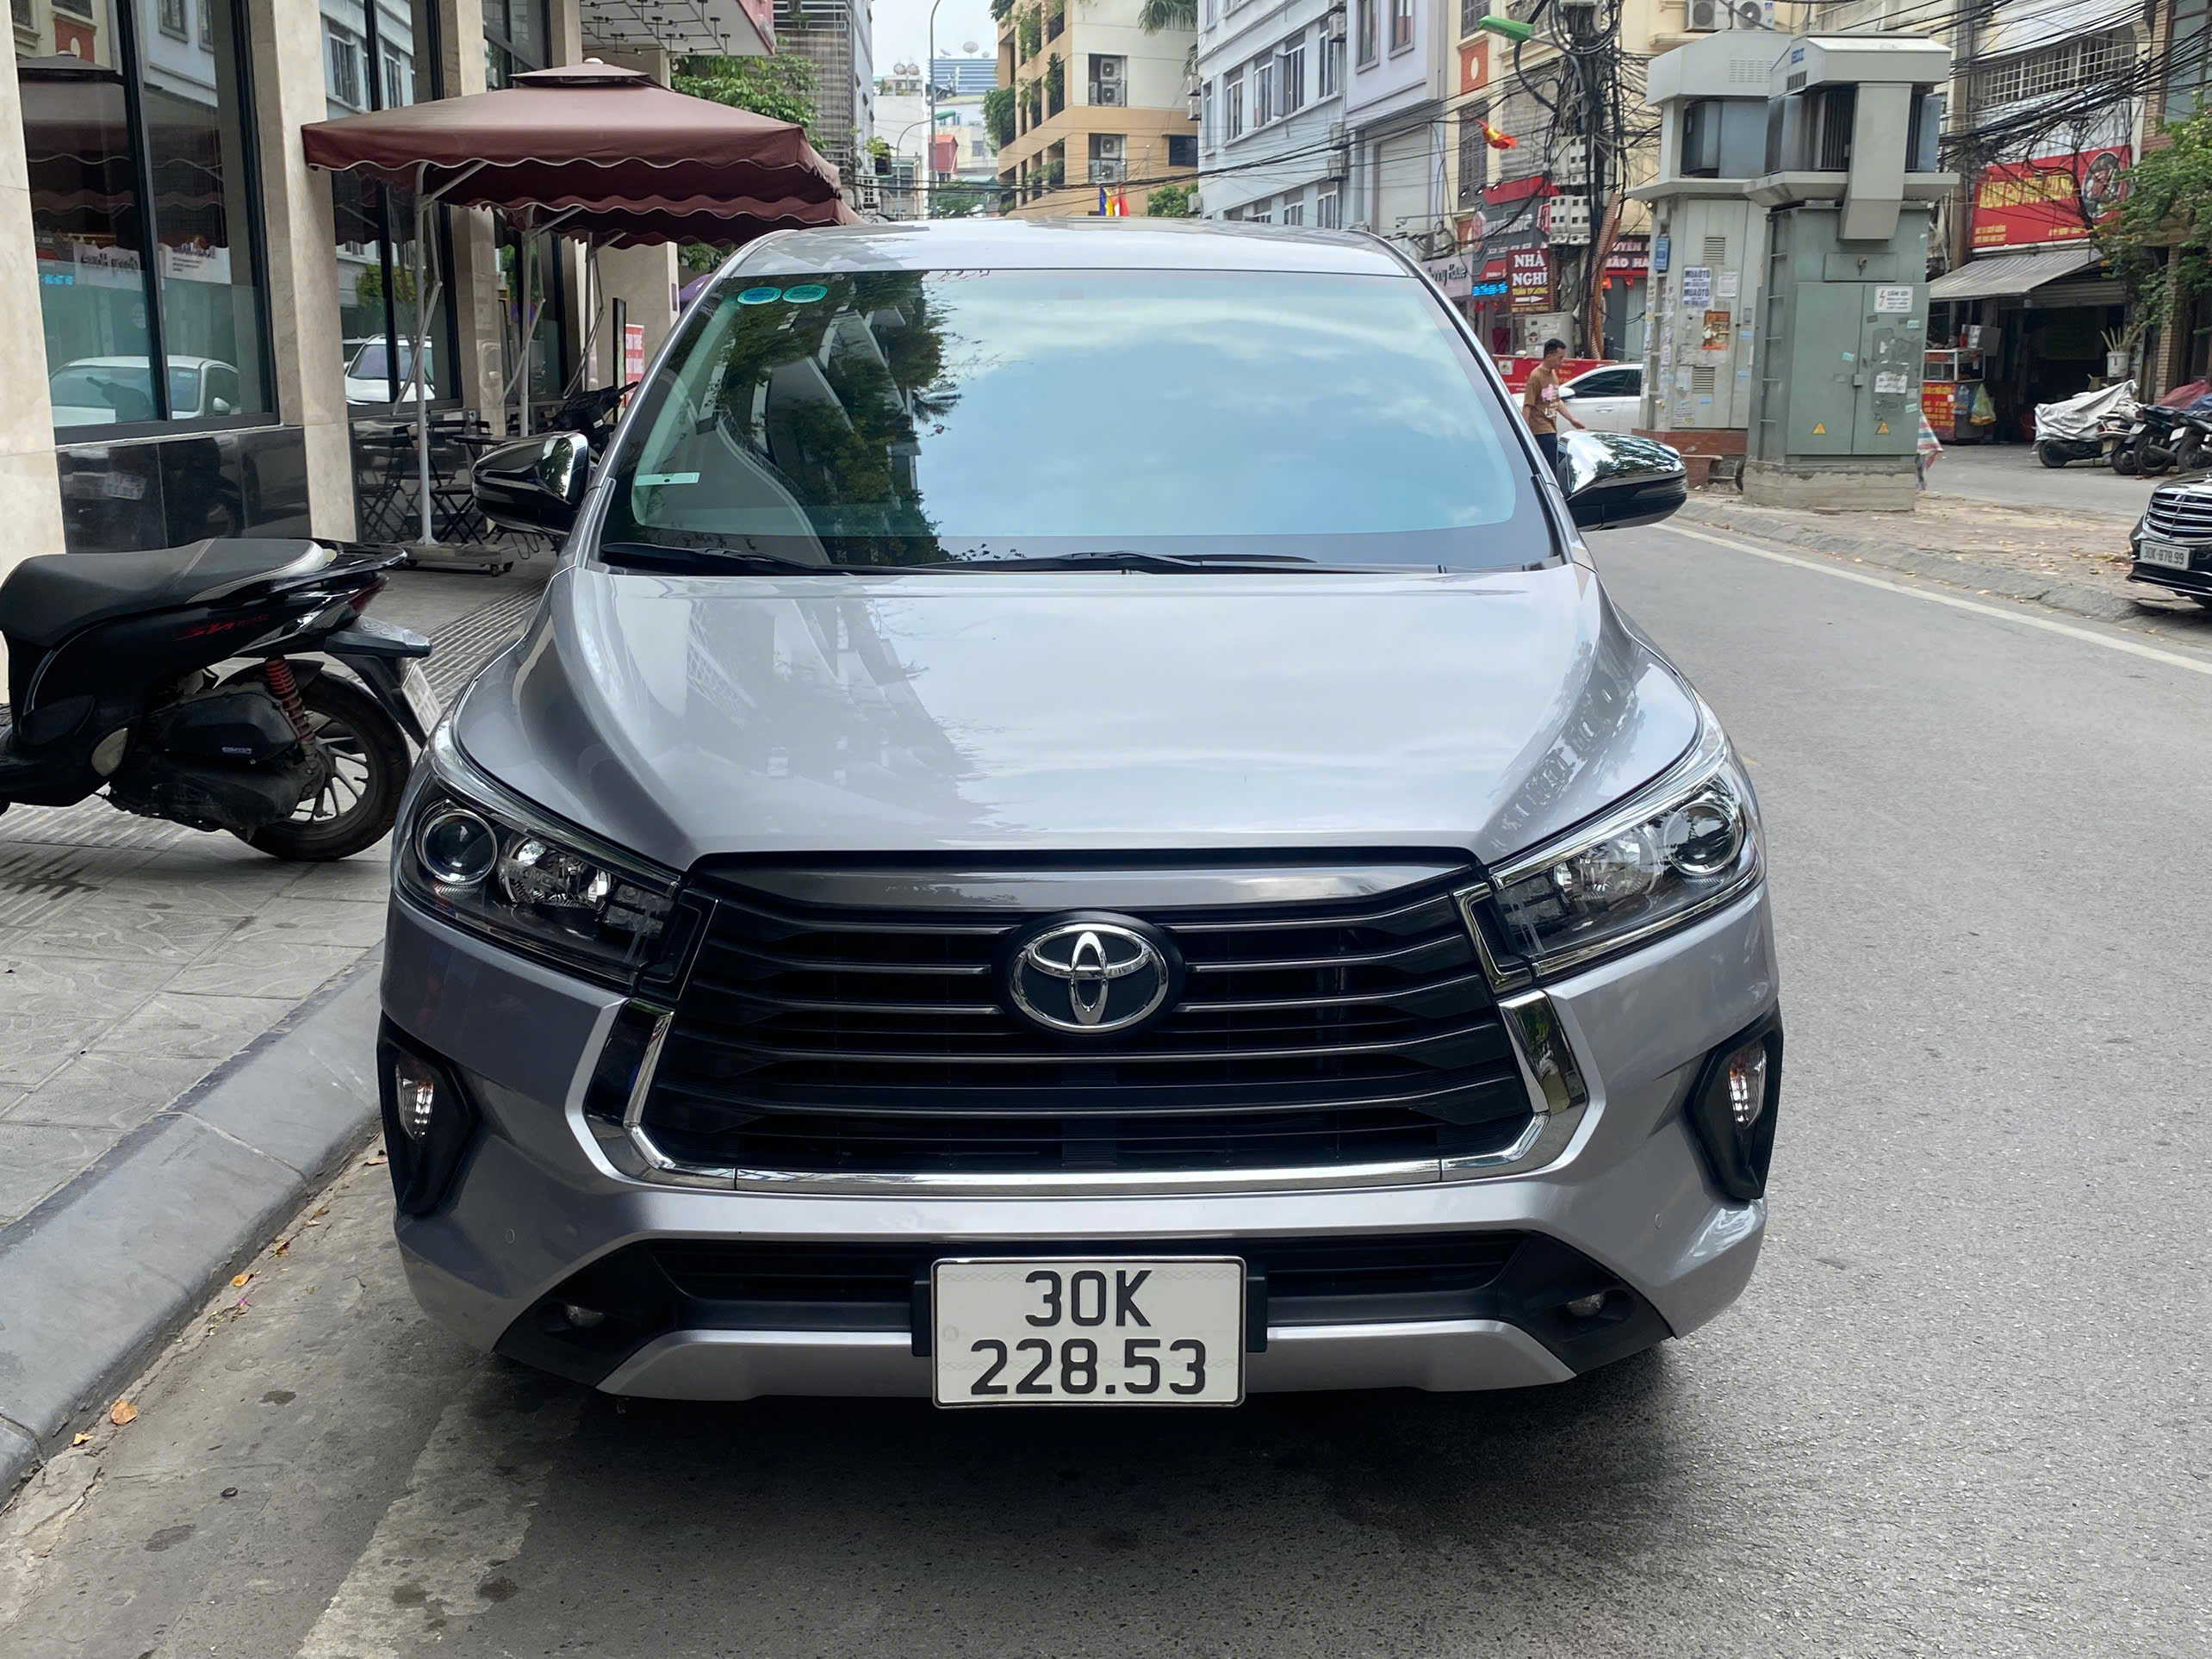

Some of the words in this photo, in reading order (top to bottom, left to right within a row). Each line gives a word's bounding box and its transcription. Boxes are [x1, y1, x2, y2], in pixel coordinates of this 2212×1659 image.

[1512, 267, 1548, 286] NGHỈ
[1513, 250, 1545, 268] NHÀ
[1025, 1270, 1153, 1327] 30K
[970, 1338, 1206, 1395] 228.53
